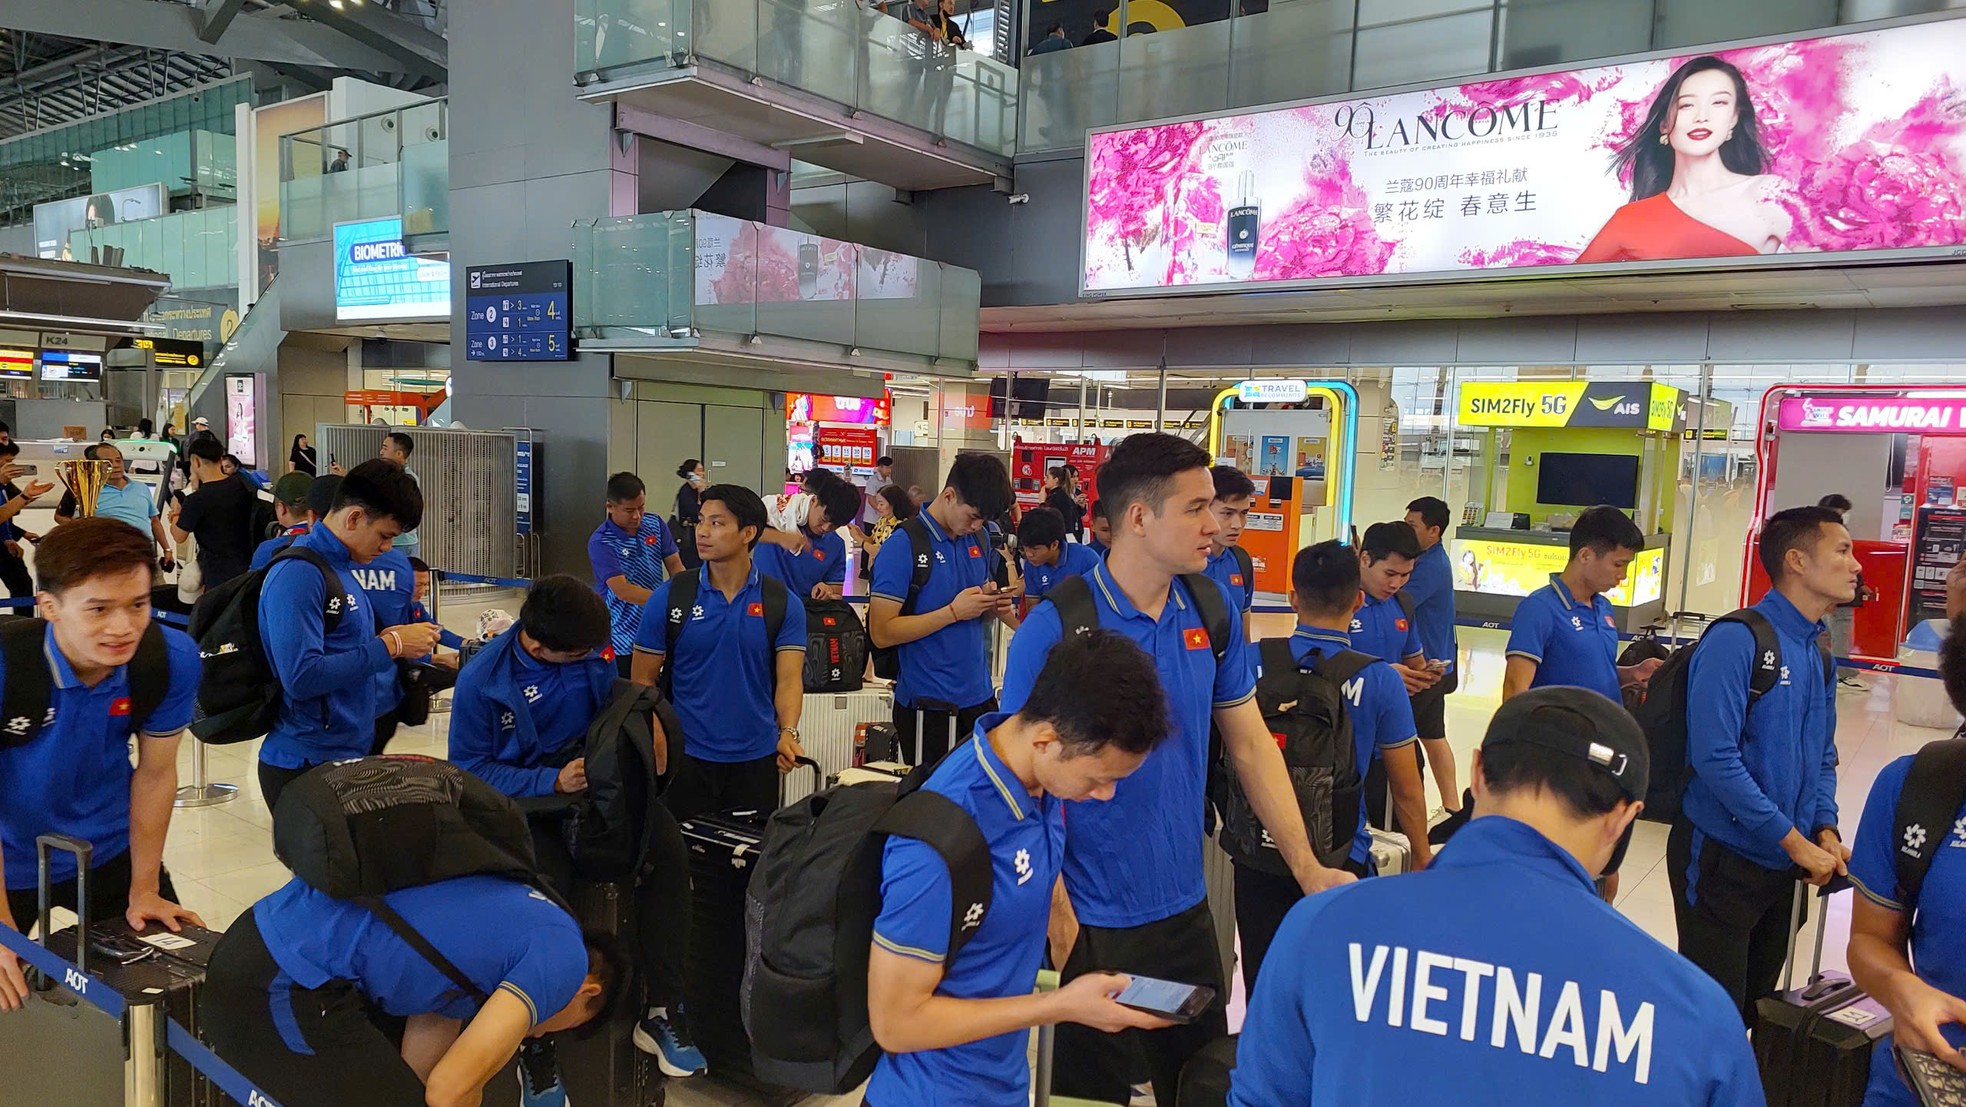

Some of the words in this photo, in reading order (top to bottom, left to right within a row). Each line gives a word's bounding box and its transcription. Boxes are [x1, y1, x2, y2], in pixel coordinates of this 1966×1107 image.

[1364, 98, 1560, 150] LANCÔME
[1380, 148, 1407, 156] BEAUTY
[1421, 142, 1459, 151] CREATING
[1461, 137, 1505, 147] HAPPINESS
[1507, 134, 1531, 142] SINCE
[1534, 130, 1558, 140] 1935
[1384, 166, 1529, 195] 兰蔻90周年幸福礼献
[1373, 197, 1445, 224] 繁花绽
[1459, 189, 1537, 218] 春意生
[470, 310, 485, 320] Zone
[517, 299, 522, 310] 3
[547, 300, 555, 320] 4
[45, 336, 69, 346] K24
[470, 340, 483, 348] Zone
[548, 334, 555, 352] 5
[1261, 384, 1301, 393] TRAVEL
[1470, 397, 1536, 418] SIM2Fly
[1540, 395, 1568, 415] 5G
[1613, 402, 1641, 415] AIS
[1835, 405, 1953, 428] SAMURAI
[1072, 446, 1097, 456] APM
[1486, 545, 1526, 559] SIM2Fly
[1528, 548, 1541, 559] 5G
[1481, 621, 1501, 629] AOT
[1872, 662, 1896, 673] AOT
[64, 967, 90, 995] AOT
[1348, 942, 1656, 1085] VIETNAM
